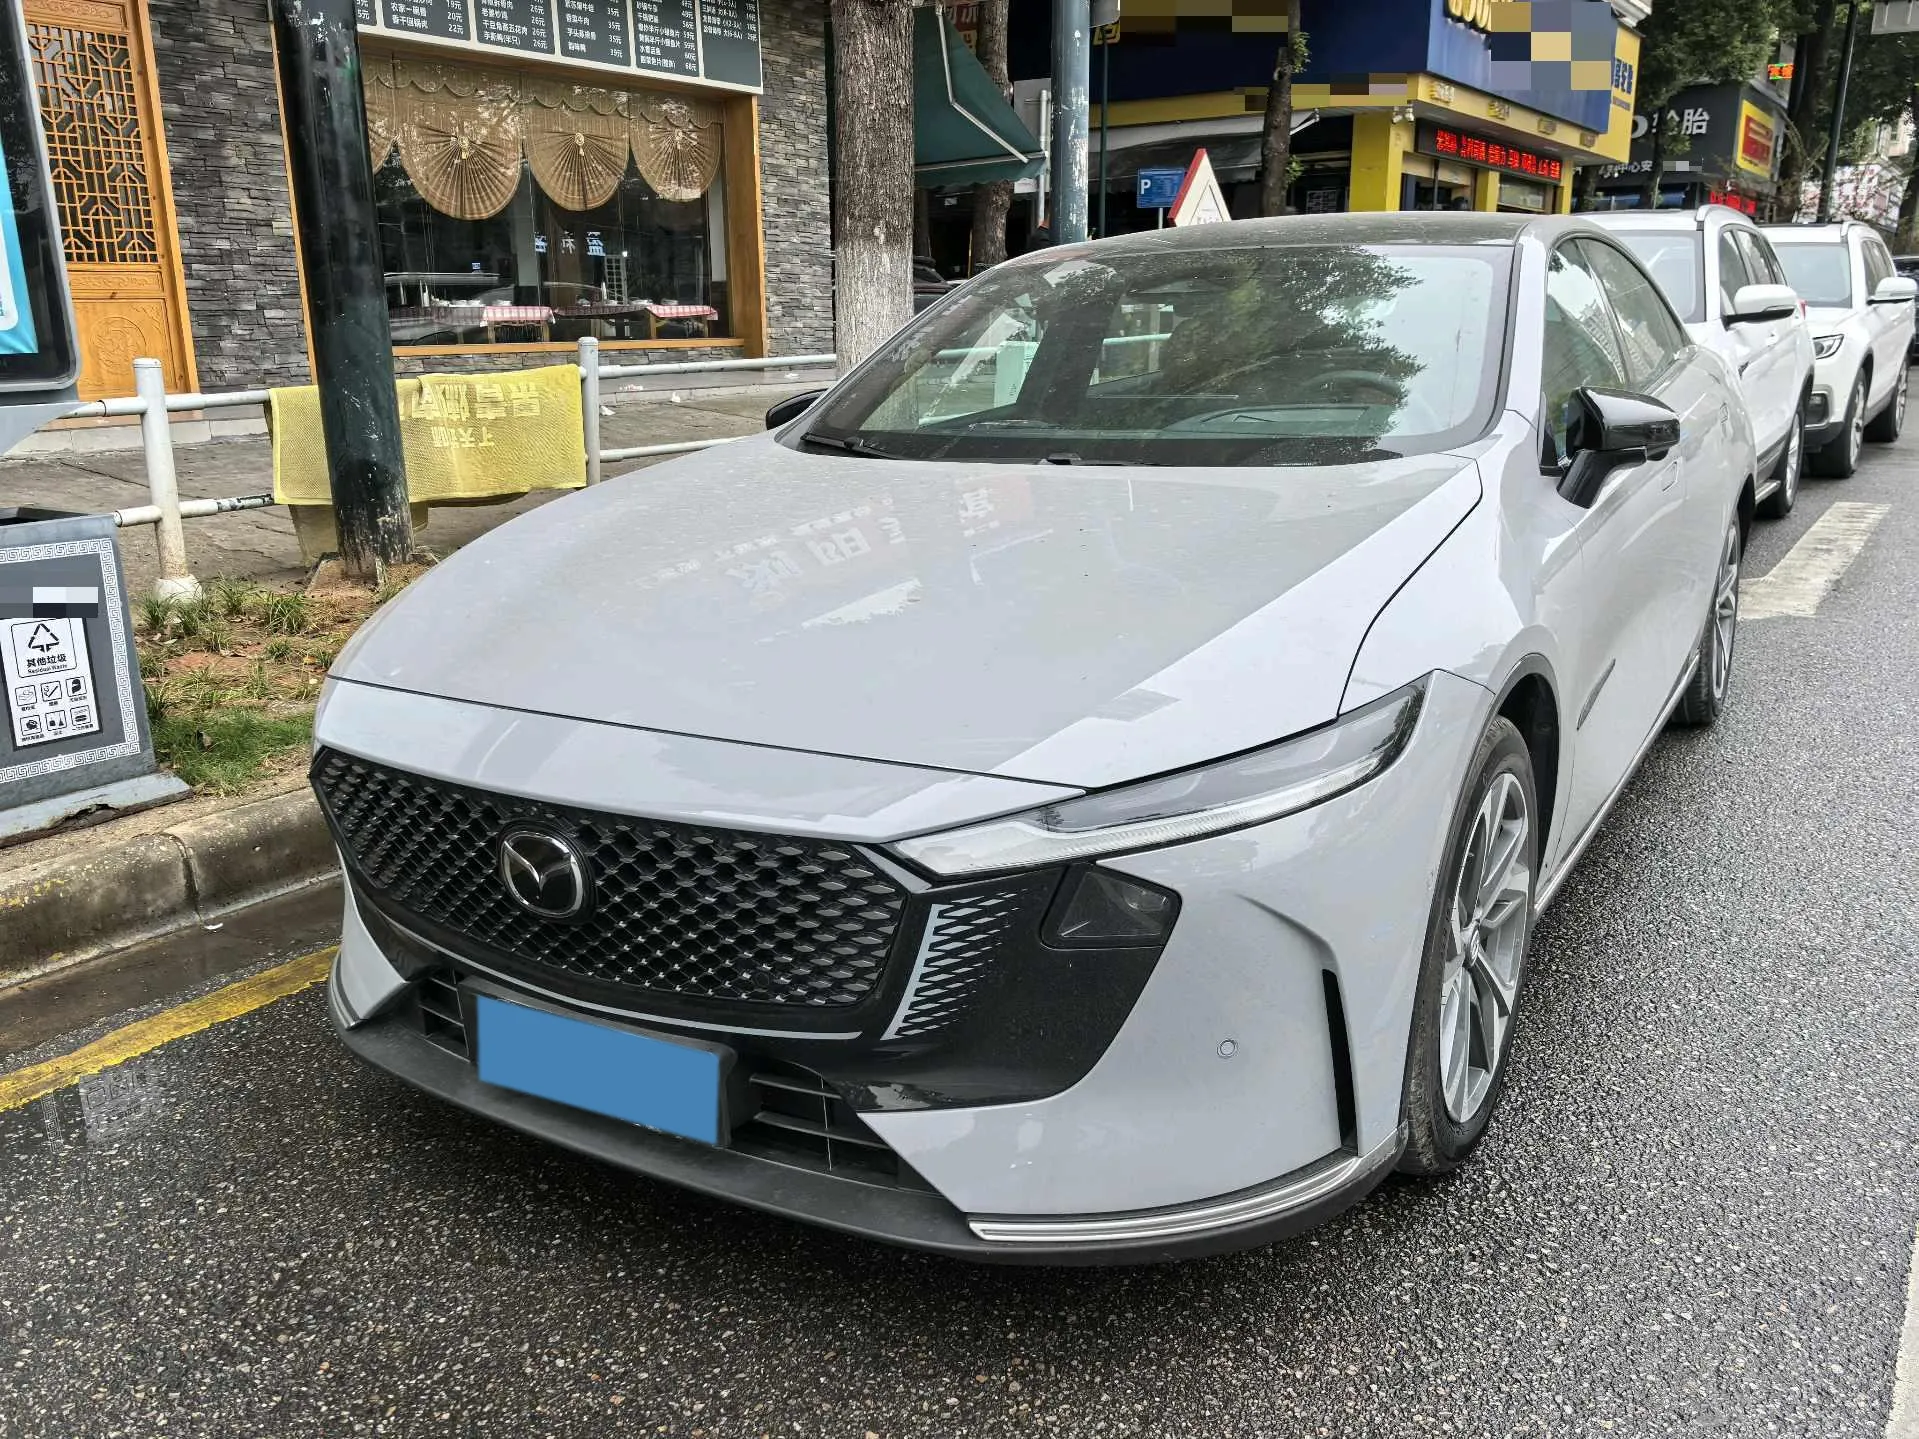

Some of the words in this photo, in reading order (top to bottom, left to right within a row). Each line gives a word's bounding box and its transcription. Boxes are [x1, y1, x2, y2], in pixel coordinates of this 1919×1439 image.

[447, 12, 463, 23] 20元
[448, 24, 464, 35] 22元
[1140, 179, 1152, 195] P
[27, 653, 67, 668] 其他垃圾
